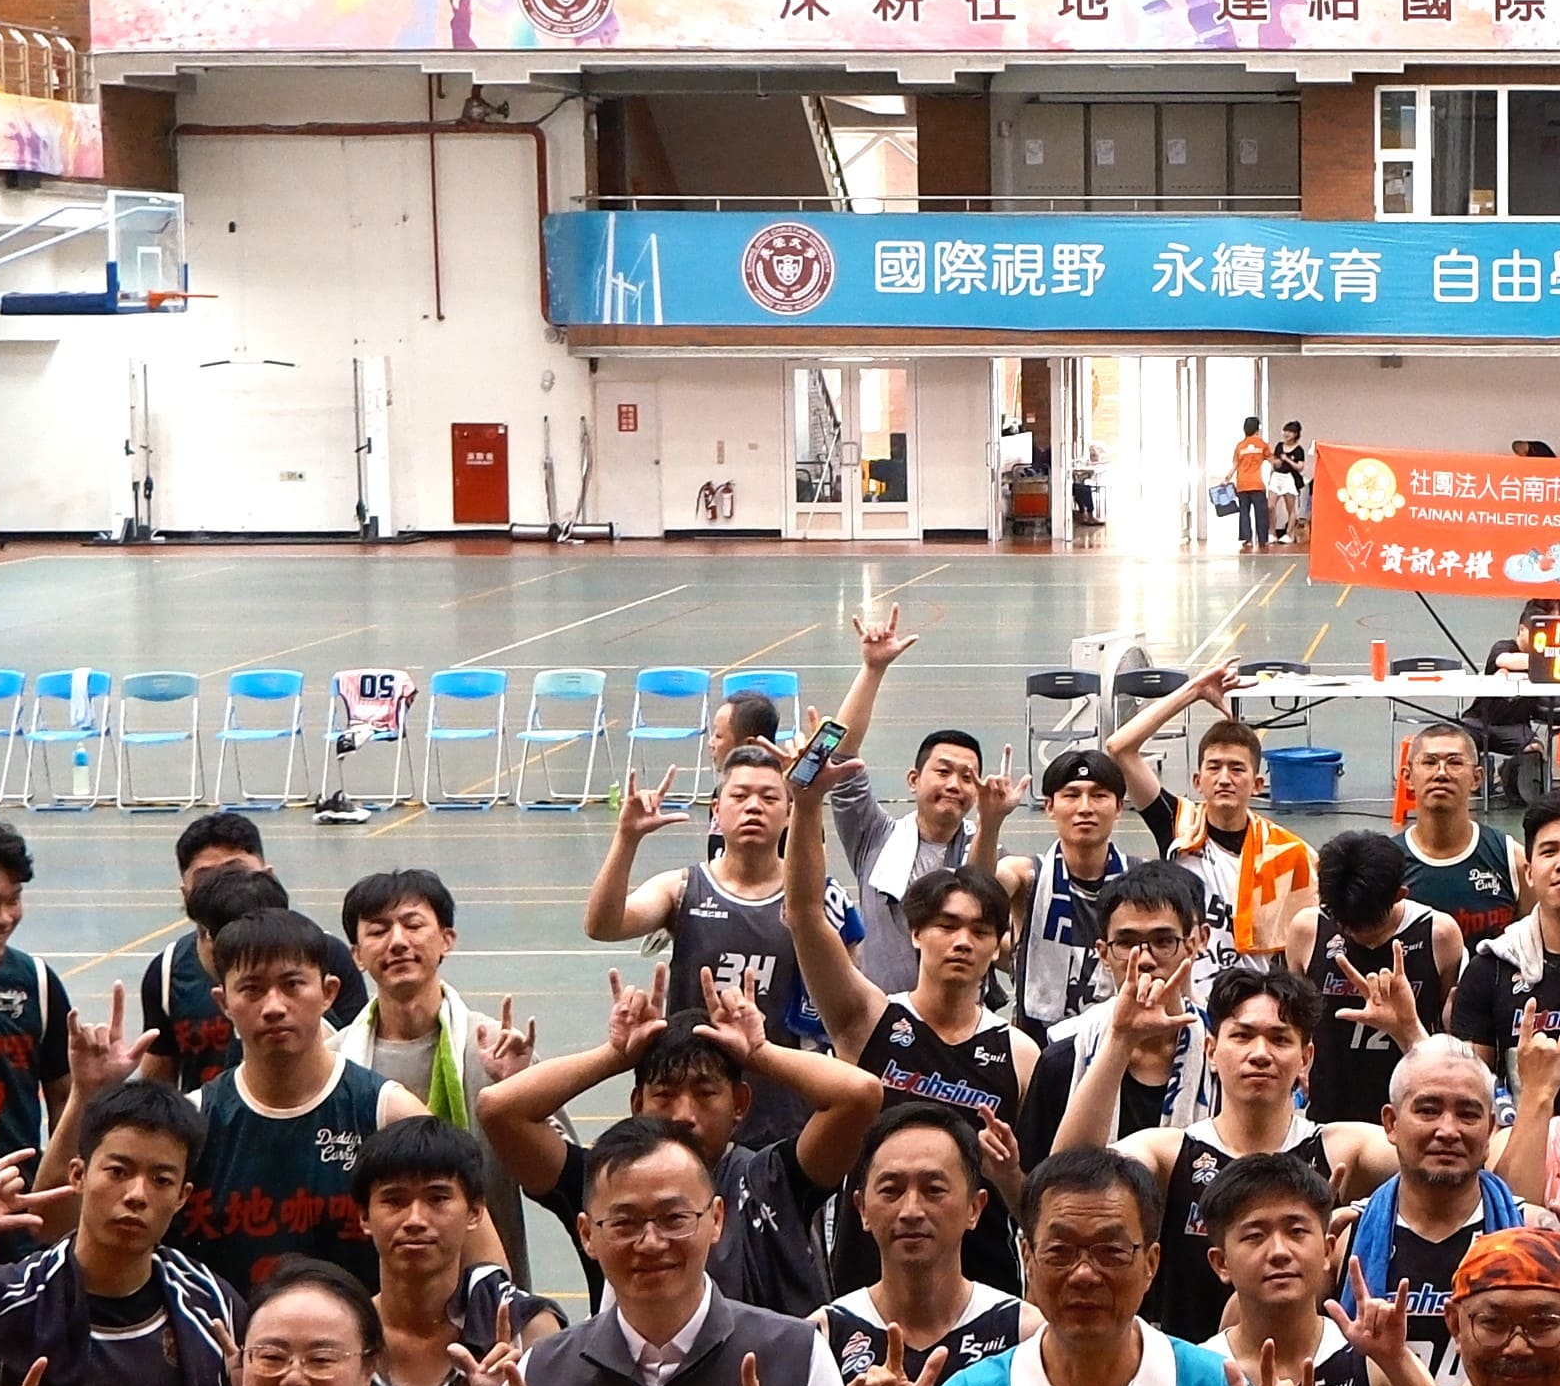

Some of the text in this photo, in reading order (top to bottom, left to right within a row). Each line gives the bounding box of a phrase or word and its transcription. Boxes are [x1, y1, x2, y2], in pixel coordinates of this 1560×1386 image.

[873, 240, 1106, 298] 國際視野
[1152, 242, 1382, 303] 永續教育
[1410, 506, 1461, 522] TAINAN
[1467, 509, 1538, 526] ATHLETIC
[1380, 544, 1494, 580] 資訊平權
